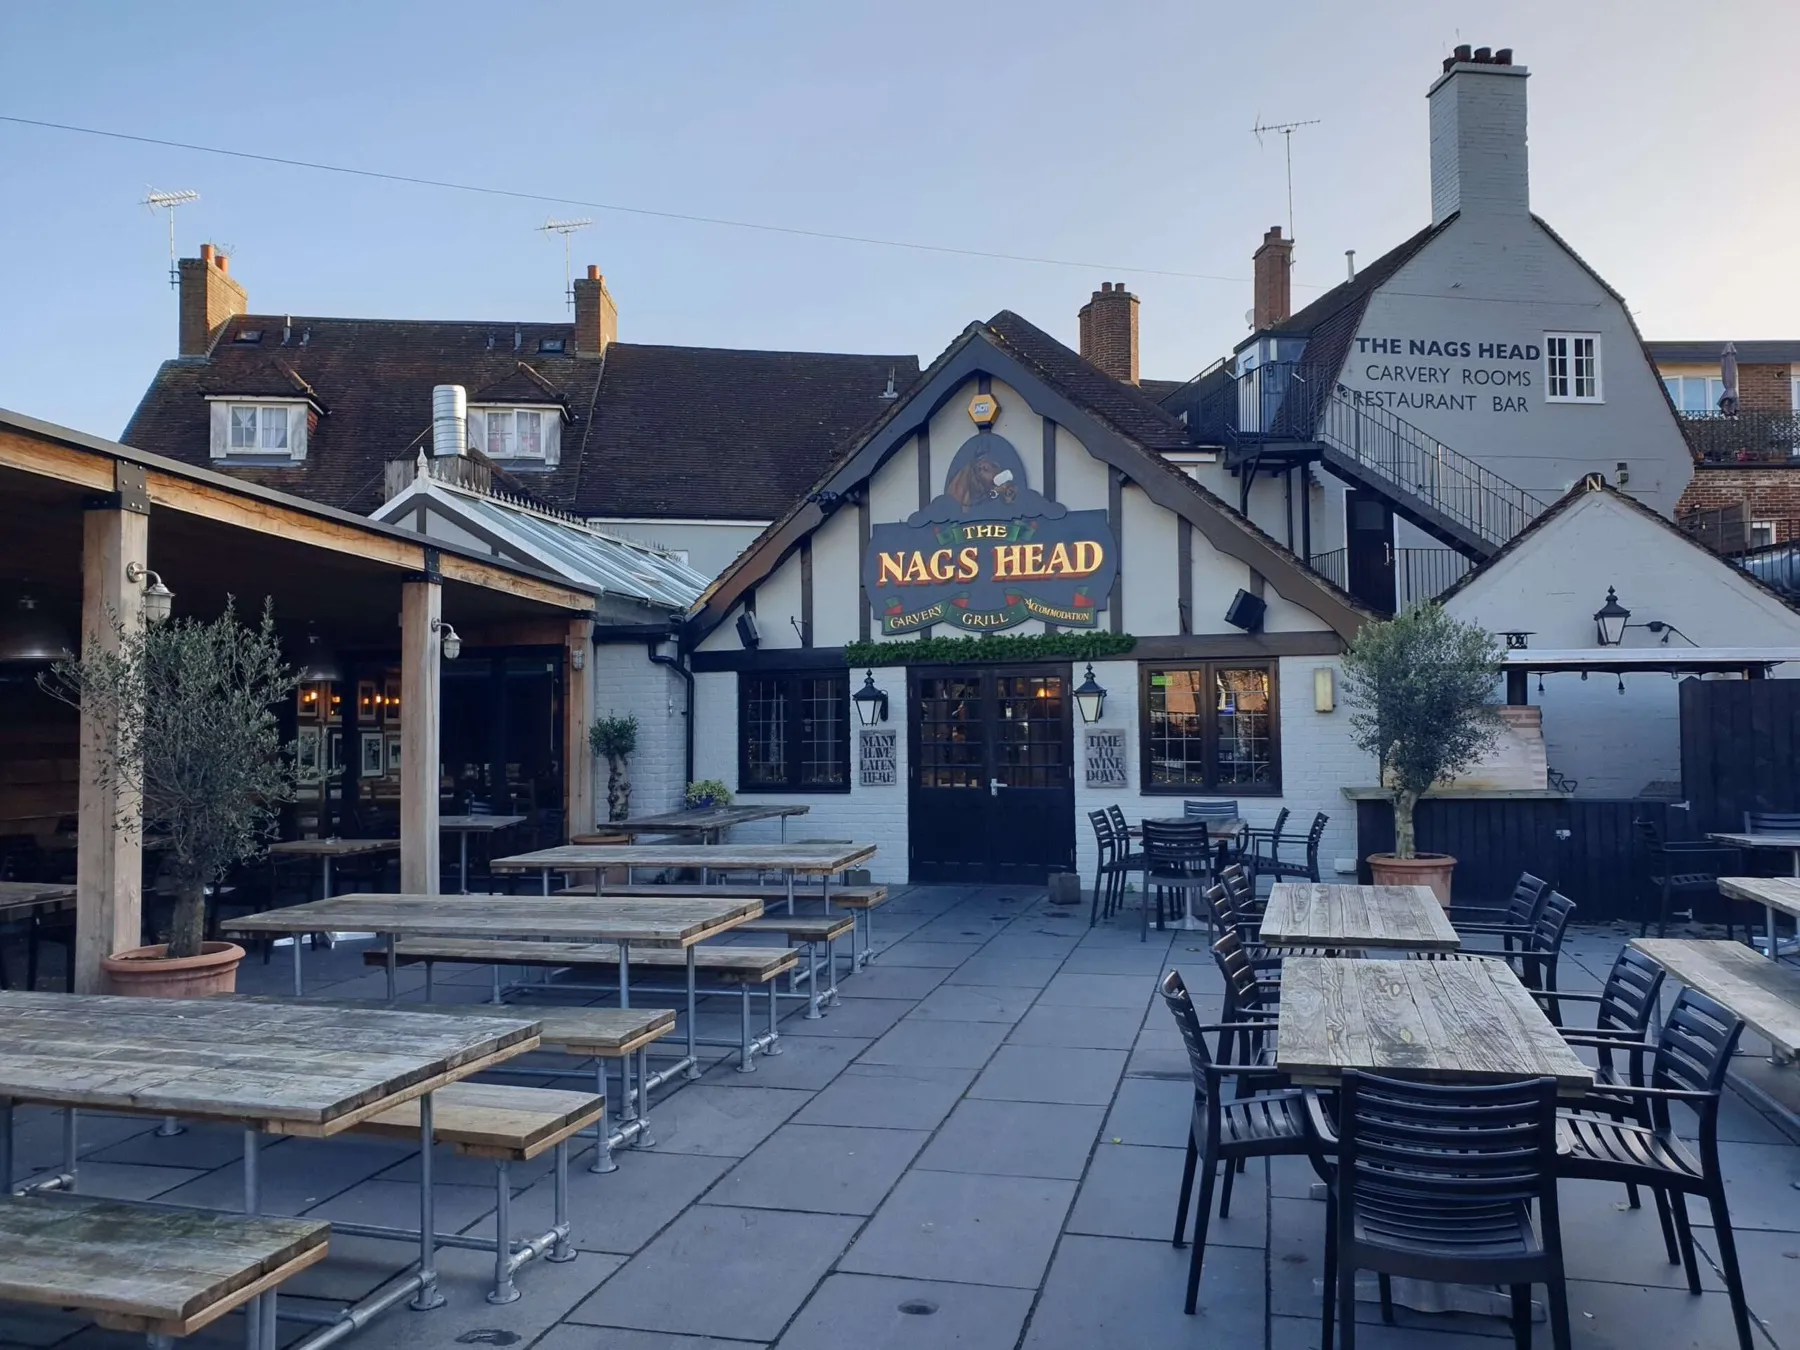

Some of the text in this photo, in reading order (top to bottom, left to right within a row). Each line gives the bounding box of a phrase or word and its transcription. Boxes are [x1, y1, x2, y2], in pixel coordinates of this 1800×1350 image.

[1355, 337, 1541, 361] THE NAGS HEAD
[1366, 364, 1531, 387] CARVERY ROOMS
[974, 403, 990, 413] ADT
[1353, 390, 1529, 413] RESTAURANT BAR
[1586, 474, 1602, 492] N
[962, 524, 1008, 540] THE
[877, 541, 1104, 586] NAGS HEAD
[1024, 598, 1090, 621] ACCOMMODATION
[890, 604, 944, 629] CARVERY
[962, 612, 1009, 627] GRILL
[862, 735, 896, 747] MANY
[1088, 735, 1122, 747] TIME
[863, 747, 893, 759] HAVE
[1095, 747, 1114, 758] TO
[860, 759, 896, 771] EATEN
[1088, 758, 1124, 769] WINE
[863, 771, 894, 783] HERE
[1086, 769, 1126, 781] DOWN
